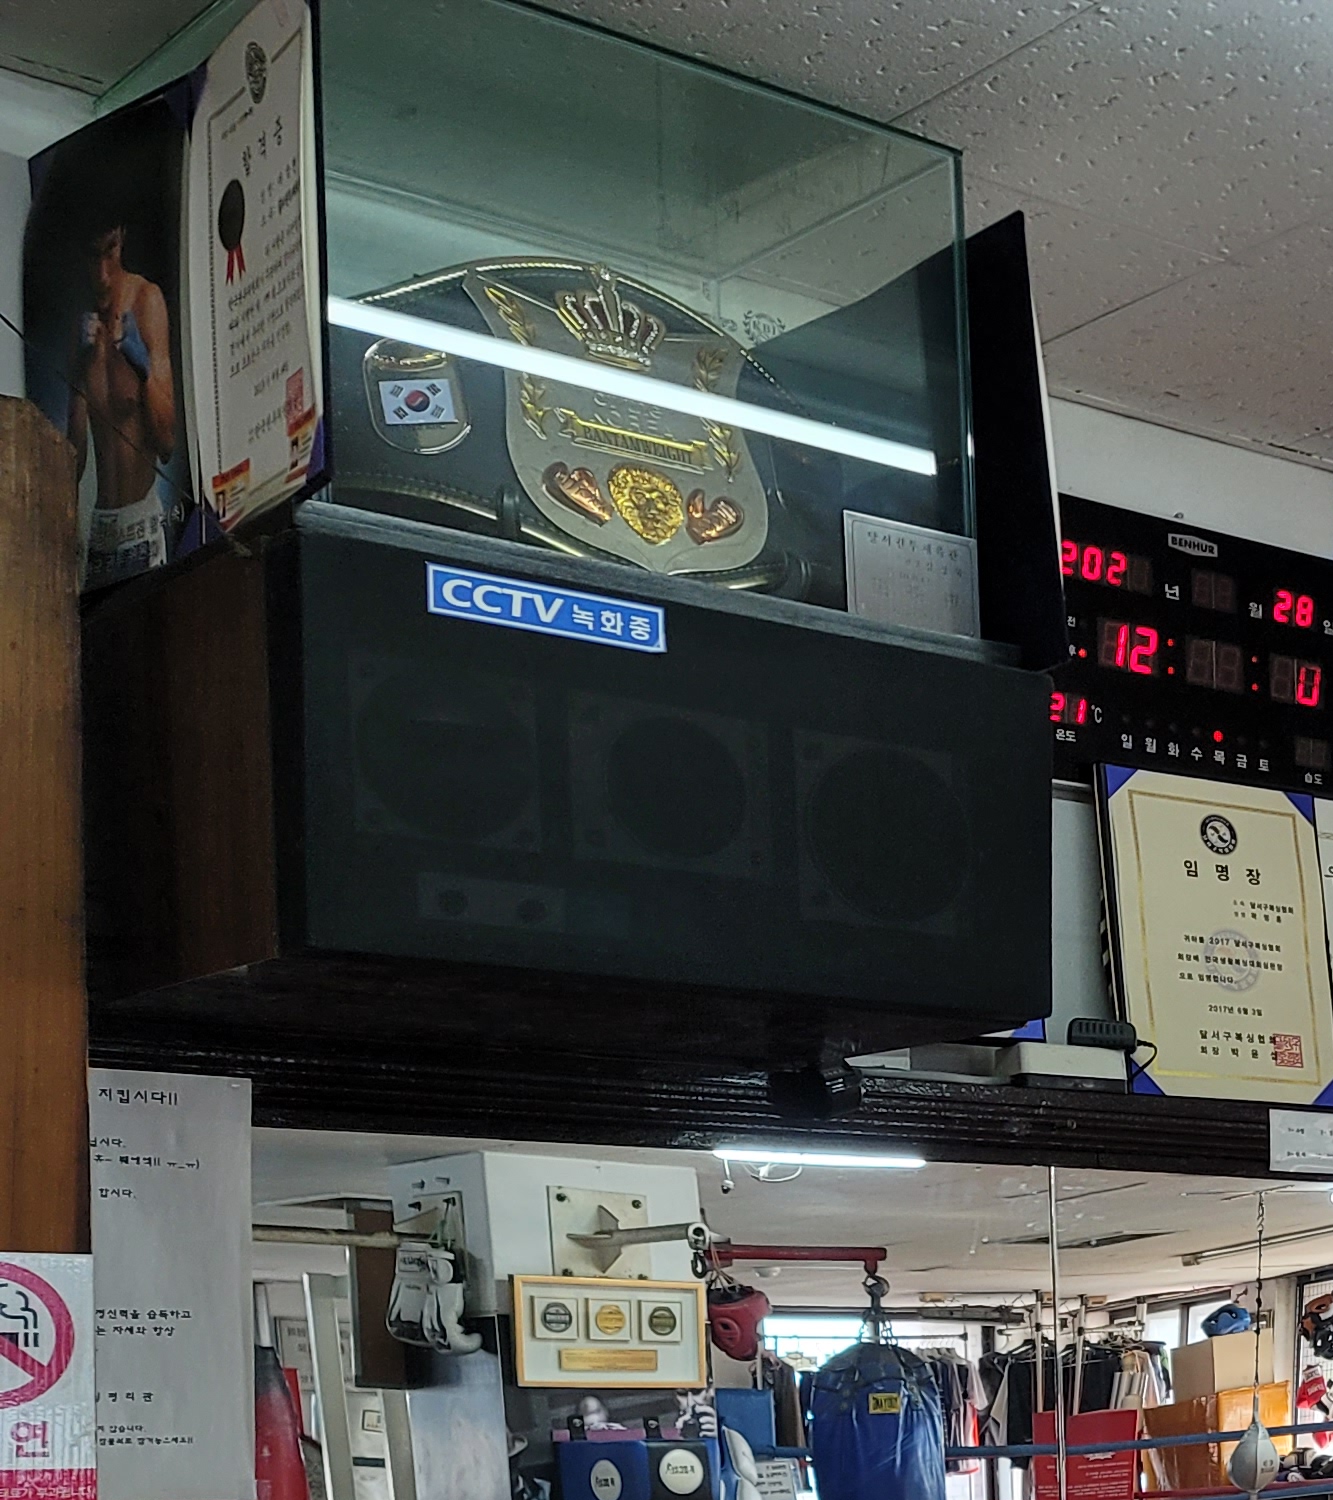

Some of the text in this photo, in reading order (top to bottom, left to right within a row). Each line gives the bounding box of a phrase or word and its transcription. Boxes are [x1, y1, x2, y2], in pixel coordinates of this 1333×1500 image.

[1170, 535, 1217, 556] BENHUR
[441, 578, 652, 641] CCTV 녹화중
[1164, 583, 1180, 601] 년
[1248, 602, 1263, 619] 월
[1273, 589, 1315, 628] 28
[1055, 729, 1077, 743] 온도
[1121, 733, 1270, 772] 일 월 화 수 목 금 토
[1209, 936, 1231, 946] 2017
[146, 1309, 193, 1320] 습득하고
